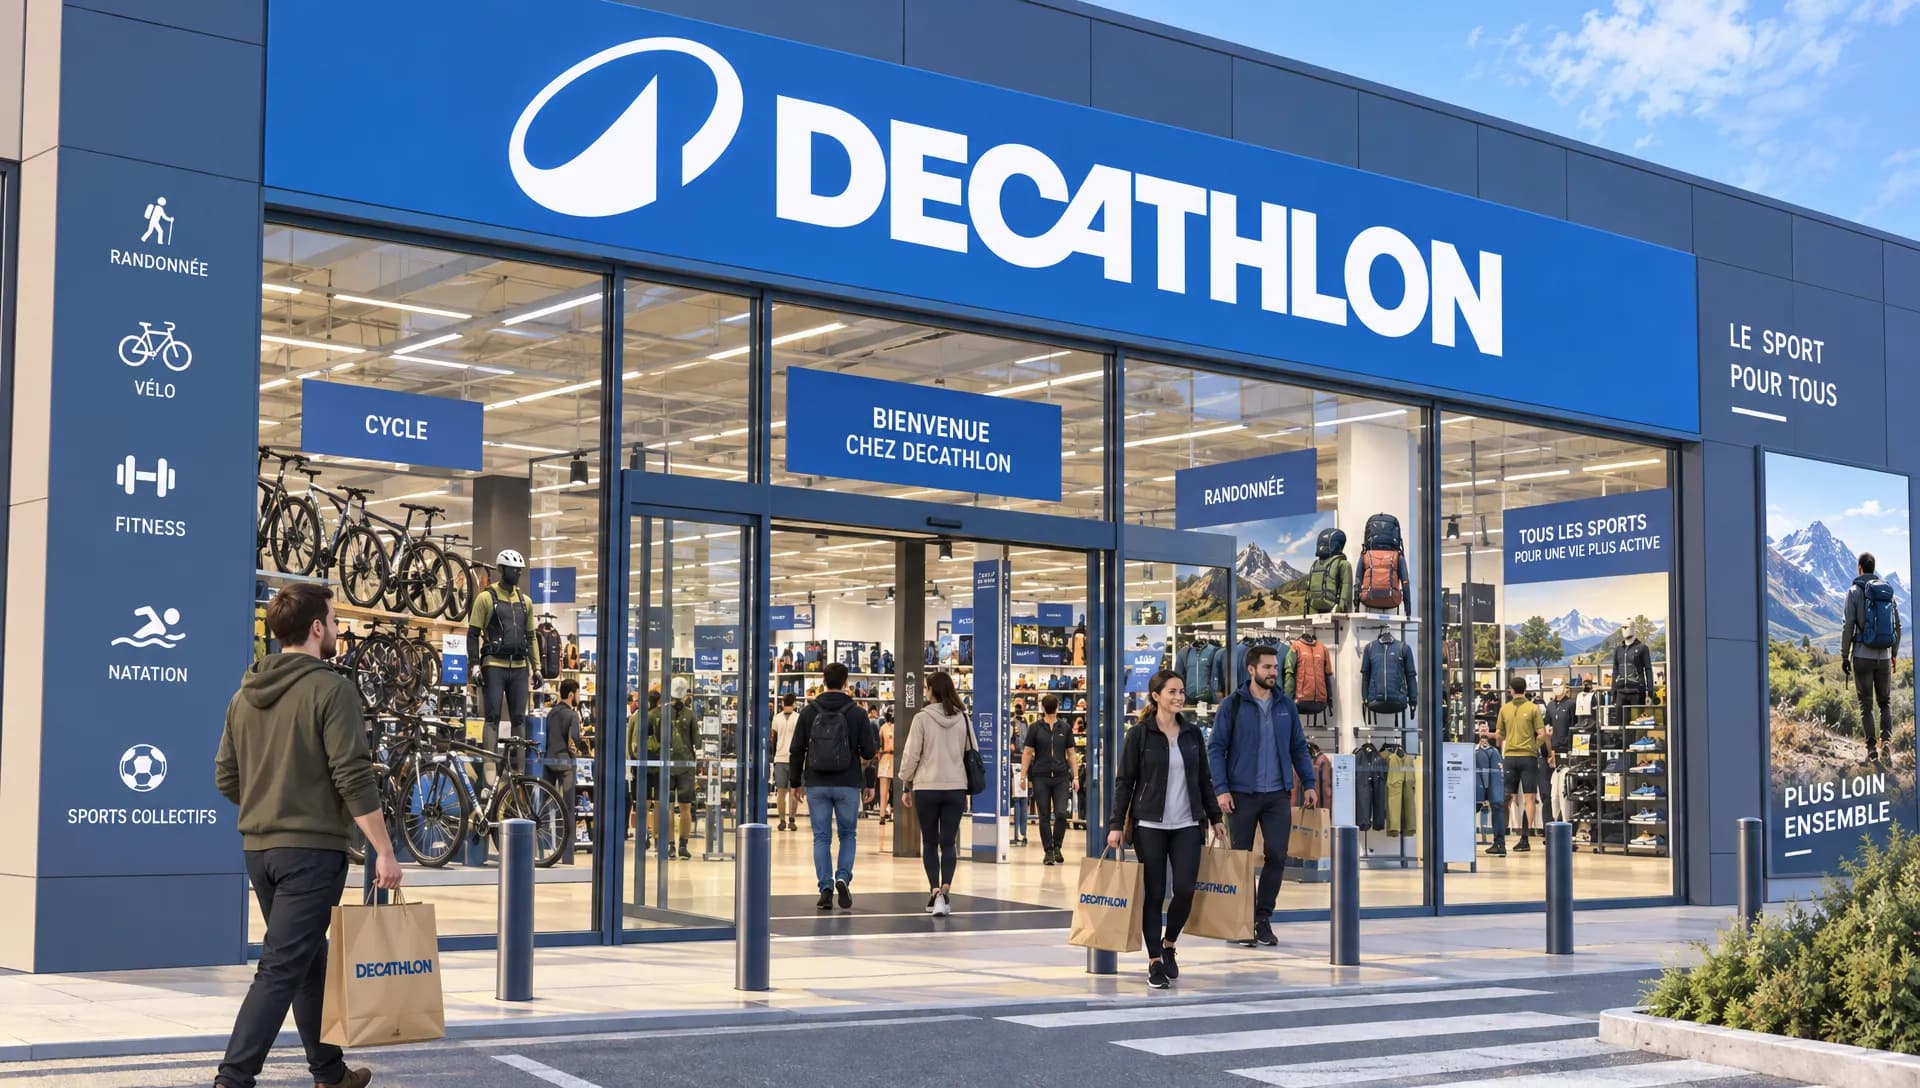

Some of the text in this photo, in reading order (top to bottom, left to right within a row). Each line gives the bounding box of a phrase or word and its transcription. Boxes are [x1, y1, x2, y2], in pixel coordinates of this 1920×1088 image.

[777, 95, 1503, 357] DECATHLON
[110, 249, 209, 278] RANDONNÉE
[1730, 322, 1825, 364] LE SPORT
[134, 377, 176, 399] VÉLO
[1730, 363, 1838, 407] POUR TOUS
[365, 414, 428, 441] CYCLE
[873, 406, 990, 443] BIENVENUE
[846, 434, 1011, 473] CHEZ DECATHLON
[1204, 475, 1285, 505] RANDONNÉE
[115, 516, 186, 537] FITNESS
[1519, 513, 1647, 545] TOUS LES SPORTS
[1514, 535, 1661, 564] POUR UNE VIE PLUS ACTIVE
[108, 664, 188, 683] NATATION
[1784, 772, 1885, 809] PLUS LOIN
[67, 808, 217, 825] SPORTS COLLECTIFS
[1785, 800, 1891, 839] ENSEMBLE
[1080, 893, 1128, 908] DECATHLON
[355, 959, 433, 979] DECATHLON
